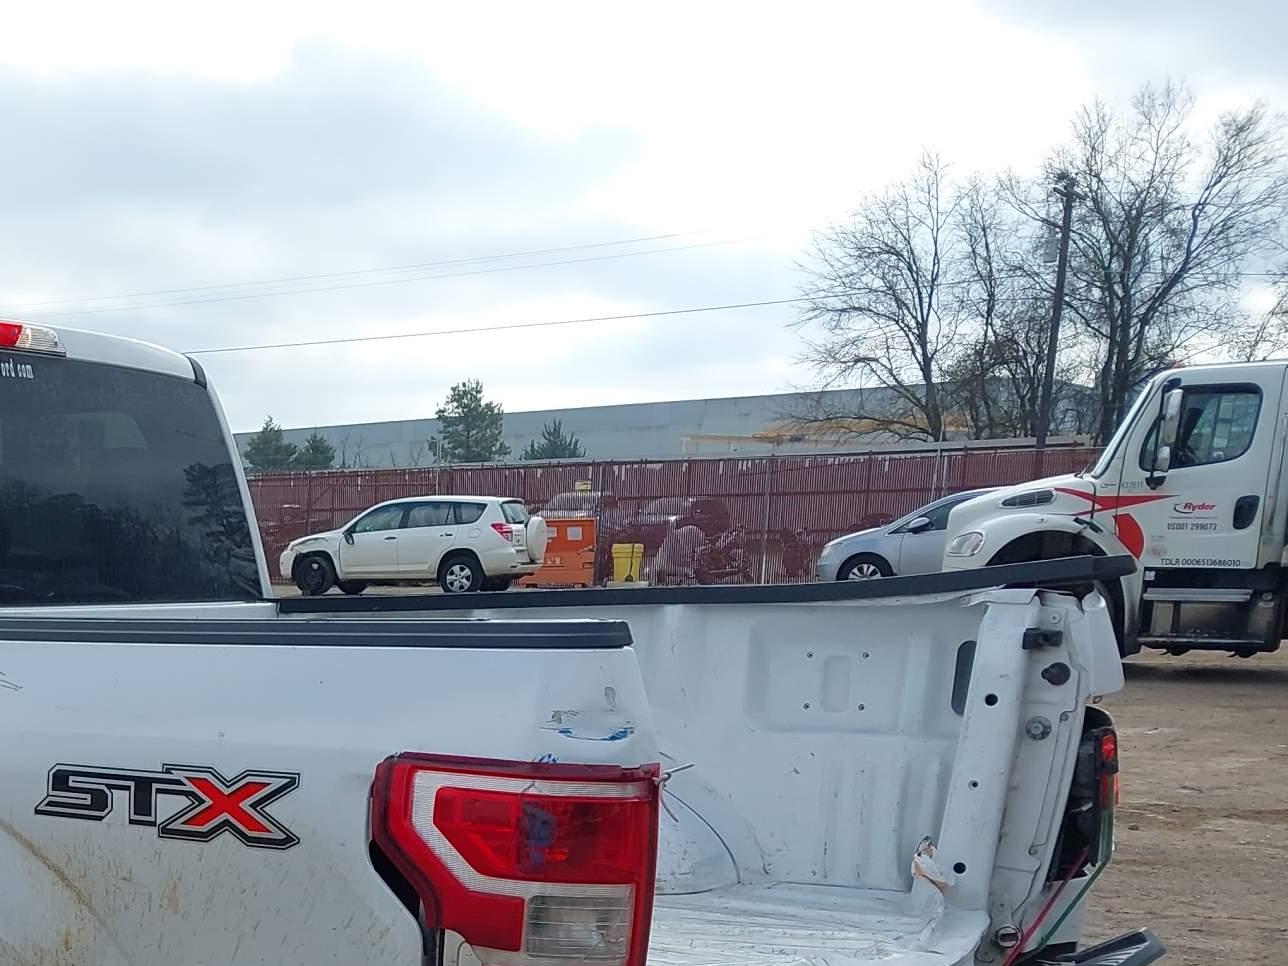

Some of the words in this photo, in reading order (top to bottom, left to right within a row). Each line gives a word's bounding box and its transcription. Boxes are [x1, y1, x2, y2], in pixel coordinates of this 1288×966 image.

[1183, 502, 1217, 512] Ryder
[1160, 558, 1181, 566] TDLR
[34, 763, 301, 850] STX
